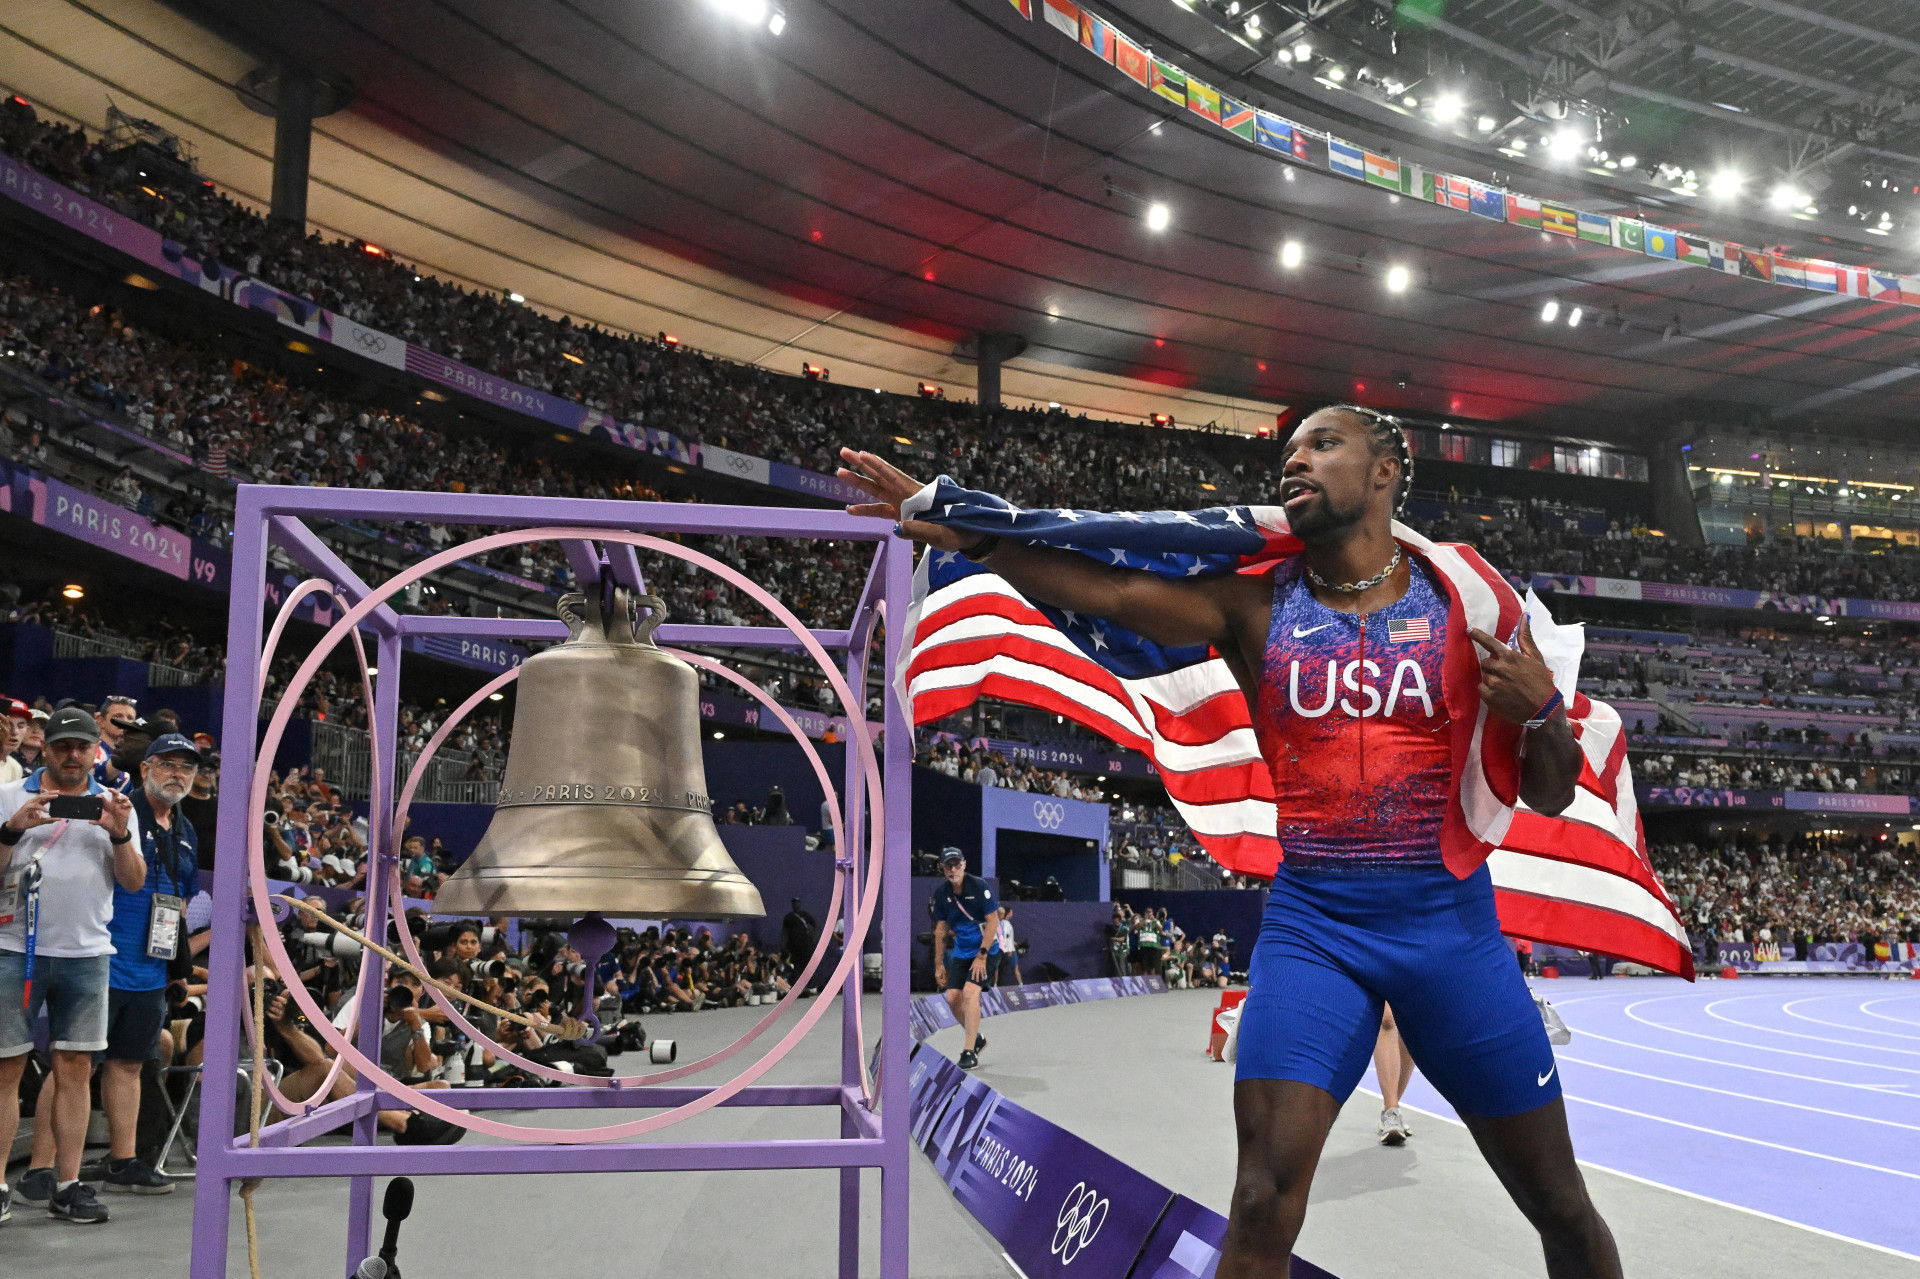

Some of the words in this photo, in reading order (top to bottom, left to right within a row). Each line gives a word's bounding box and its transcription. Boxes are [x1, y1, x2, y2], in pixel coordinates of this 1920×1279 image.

[0, 165, 42, 200] RIS
[53, 192, 113, 235] 2024
[500, 387, 545, 412] 2024
[129, 525, 182, 564] 2024
[1289, 659, 1434, 718] USA
[1051, 750, 1083, 765] 2024
[1719, 949, 1751, 962] 202
[1001, 1155, 1039, 1202] 2024
